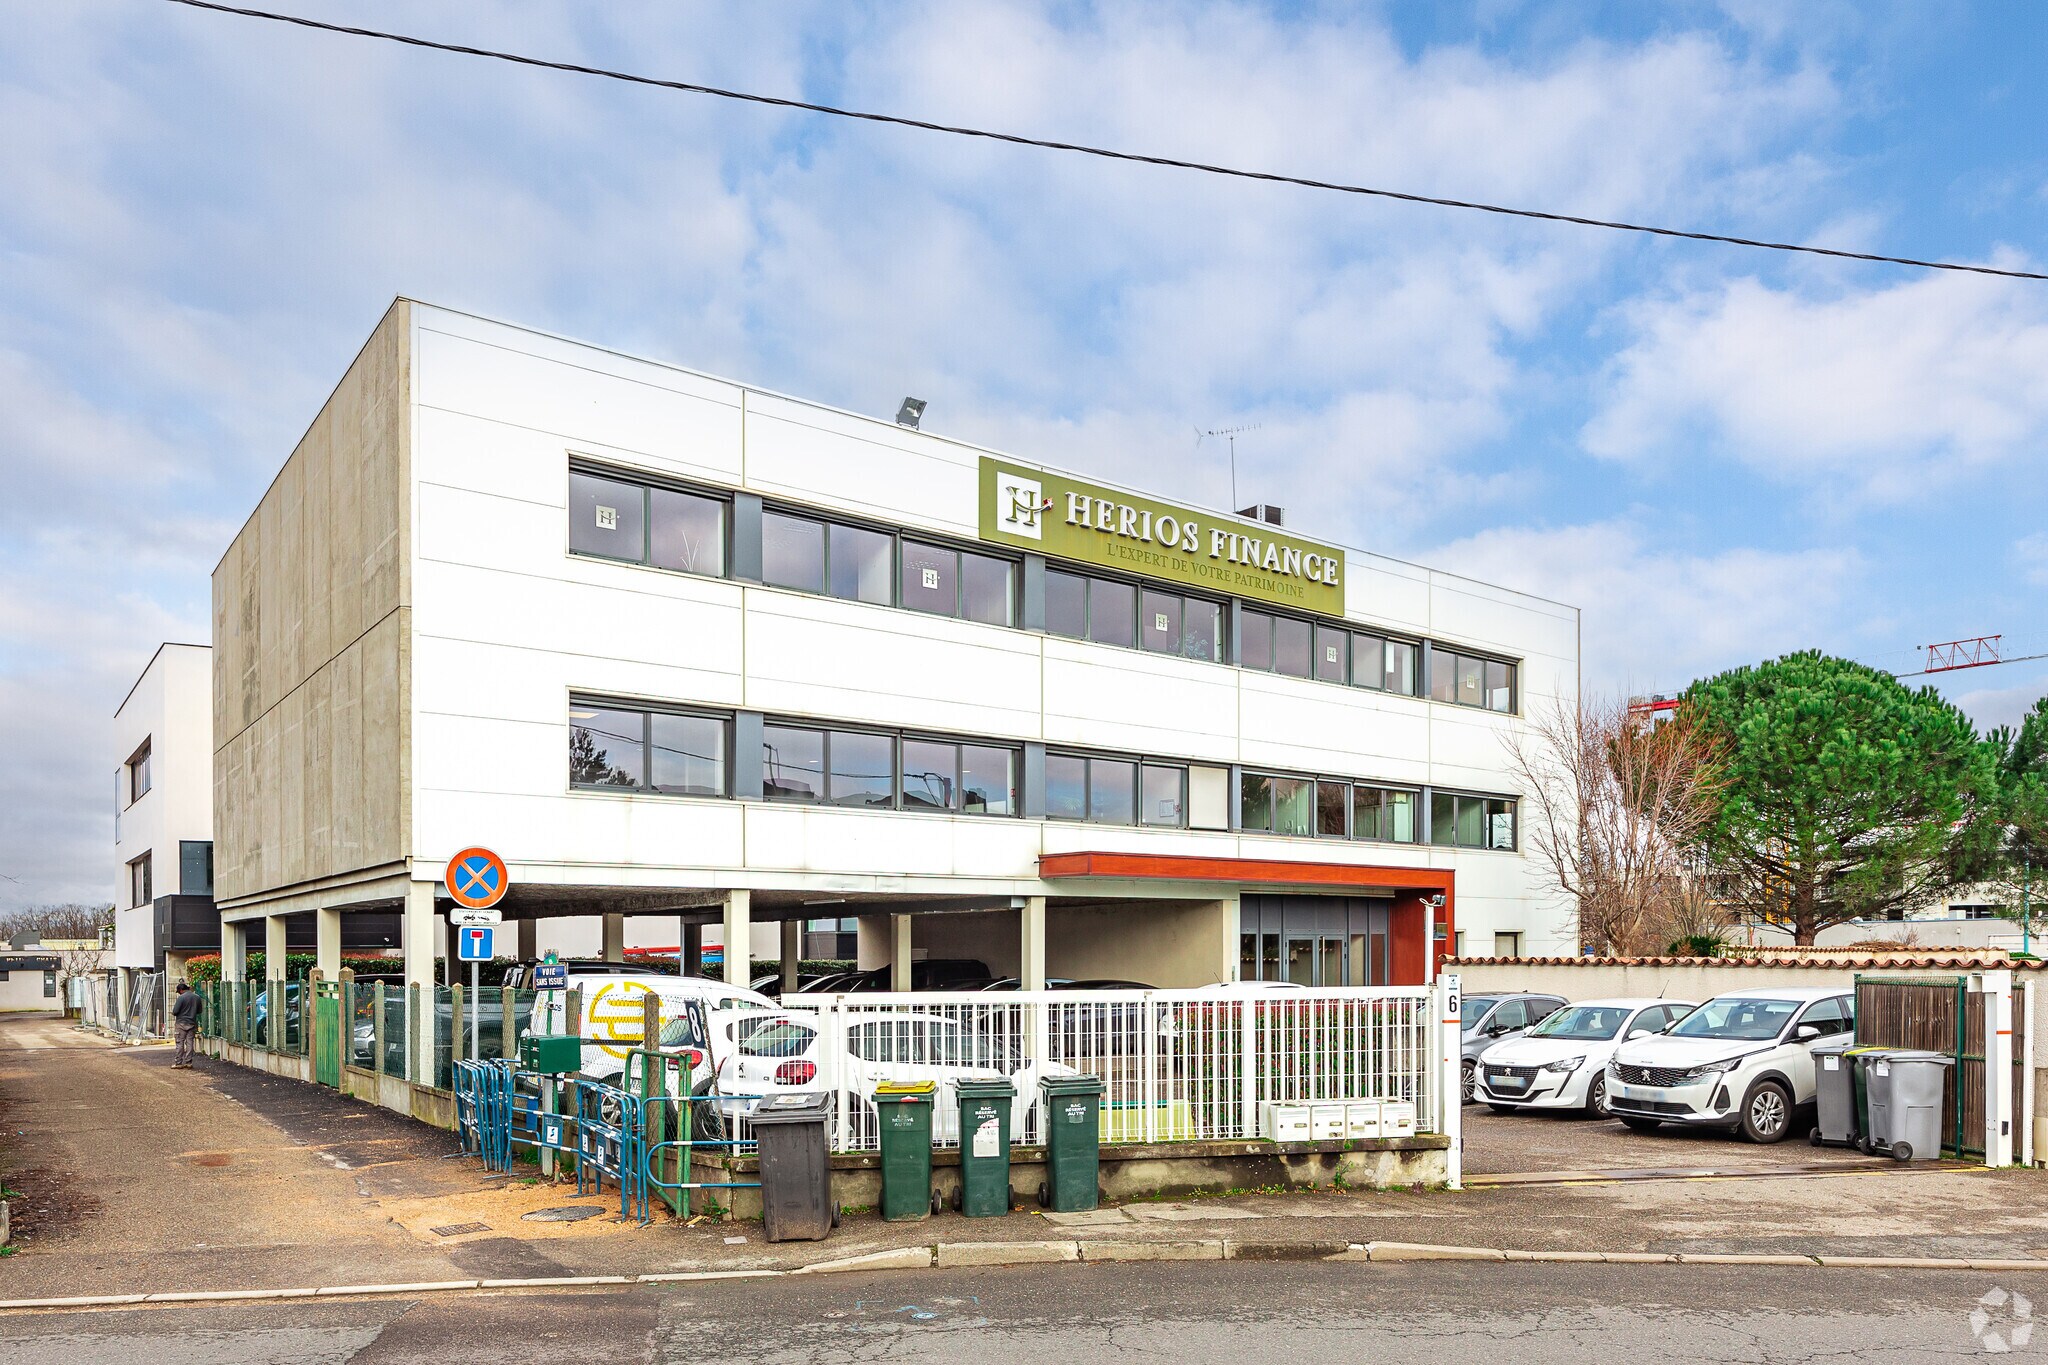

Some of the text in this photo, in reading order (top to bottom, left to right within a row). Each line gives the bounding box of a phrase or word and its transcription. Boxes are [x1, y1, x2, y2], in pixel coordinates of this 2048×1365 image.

[1065, 491, 1339, 587] HERIOS FINANCE
[1107, 542, 1305, 599] L'EXPERT DE VOTRE PATRIMOINE
[536, 977, 564, 986] SANS ISSUE
[542, 967, 556, 976] VOIE
[1449, 995, 1457, 1013] 6
[687, 1006, 702, 1043] 8
